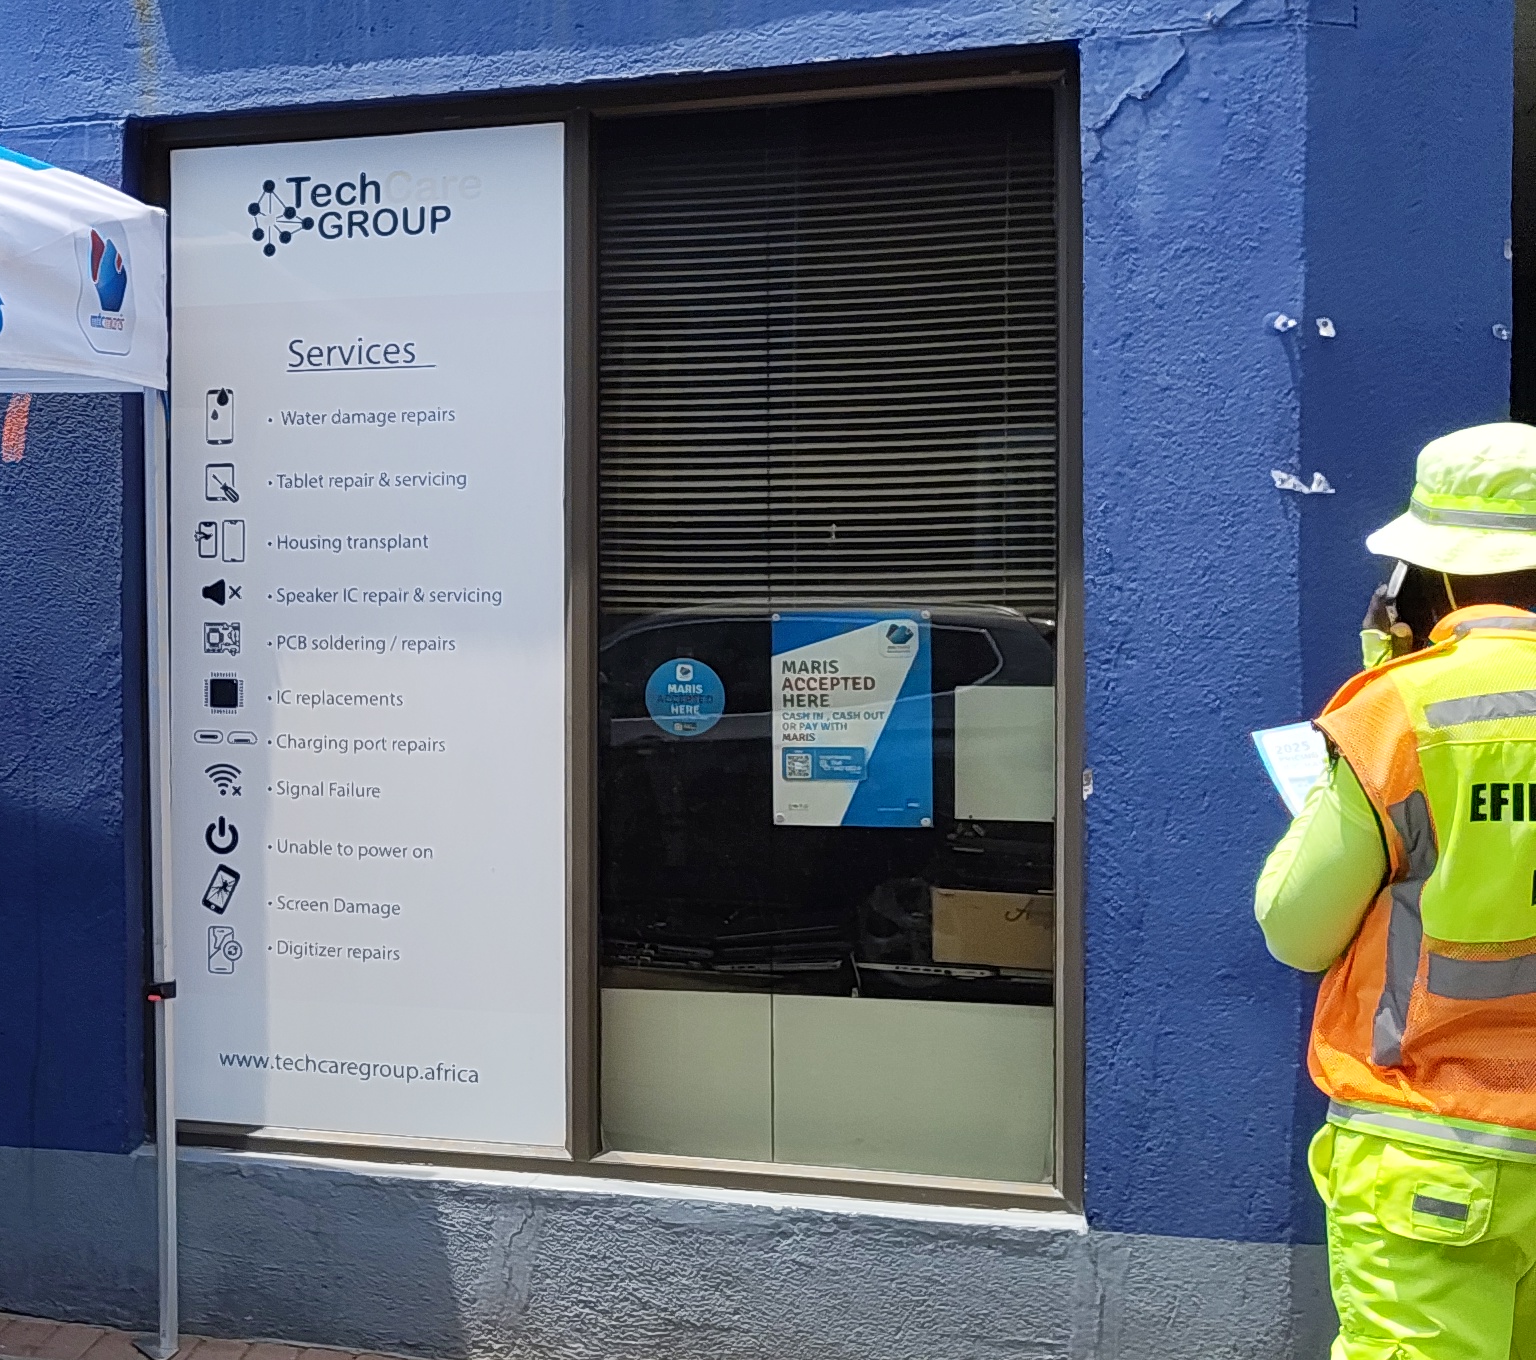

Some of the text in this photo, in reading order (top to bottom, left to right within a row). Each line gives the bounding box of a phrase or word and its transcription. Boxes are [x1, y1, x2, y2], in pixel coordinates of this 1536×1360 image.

[285, 173, 381, 208] Tech
[317, 205, 452, 240] GROUP
[289, 339, 415, 368] Services
[281, 407, 455, 427] Water damage repairs
[277, 472, 466, 491] Tablet repair & servicing
[278, 534, 428, 553] Housing transplant
[277, 588, 501, 606] Speaker IC repair & servicing
[278, 635, 307, 650] PCB
[312, 635, 385, 654] soldering
[402, 636, 455, 654] repairs
[782, 660, 839, 675] MARIS
[667, 683, 704, 694] MARIS
[782, 676, 876, 691] ACCEPTED
[278, 690, 403, 709] IC replacements
[670, 704, 700, 714] HERE
[782, 694, 830, 708] HERE
[813, 712, 823, 720] IN
[832, 712, 860, 720] CASH
[782, 723, 796, 731] OR
[800, 723, 818, 731] PAY
[277, 734, 445, 754] Charging port repairs
[782, 733, 815, 741] MARIS
[1275, 741, 1311, 755] 2025
[277, 781, 380, 799] Signal Failure
[278, 839, 432, 860] Unable to power on
[278, 896, 400, 918] Screen Damage
[278, 940, 400, 962] Digitizer repairs
[219, 1053, 478, 1083] www.techcaregroup.africa
